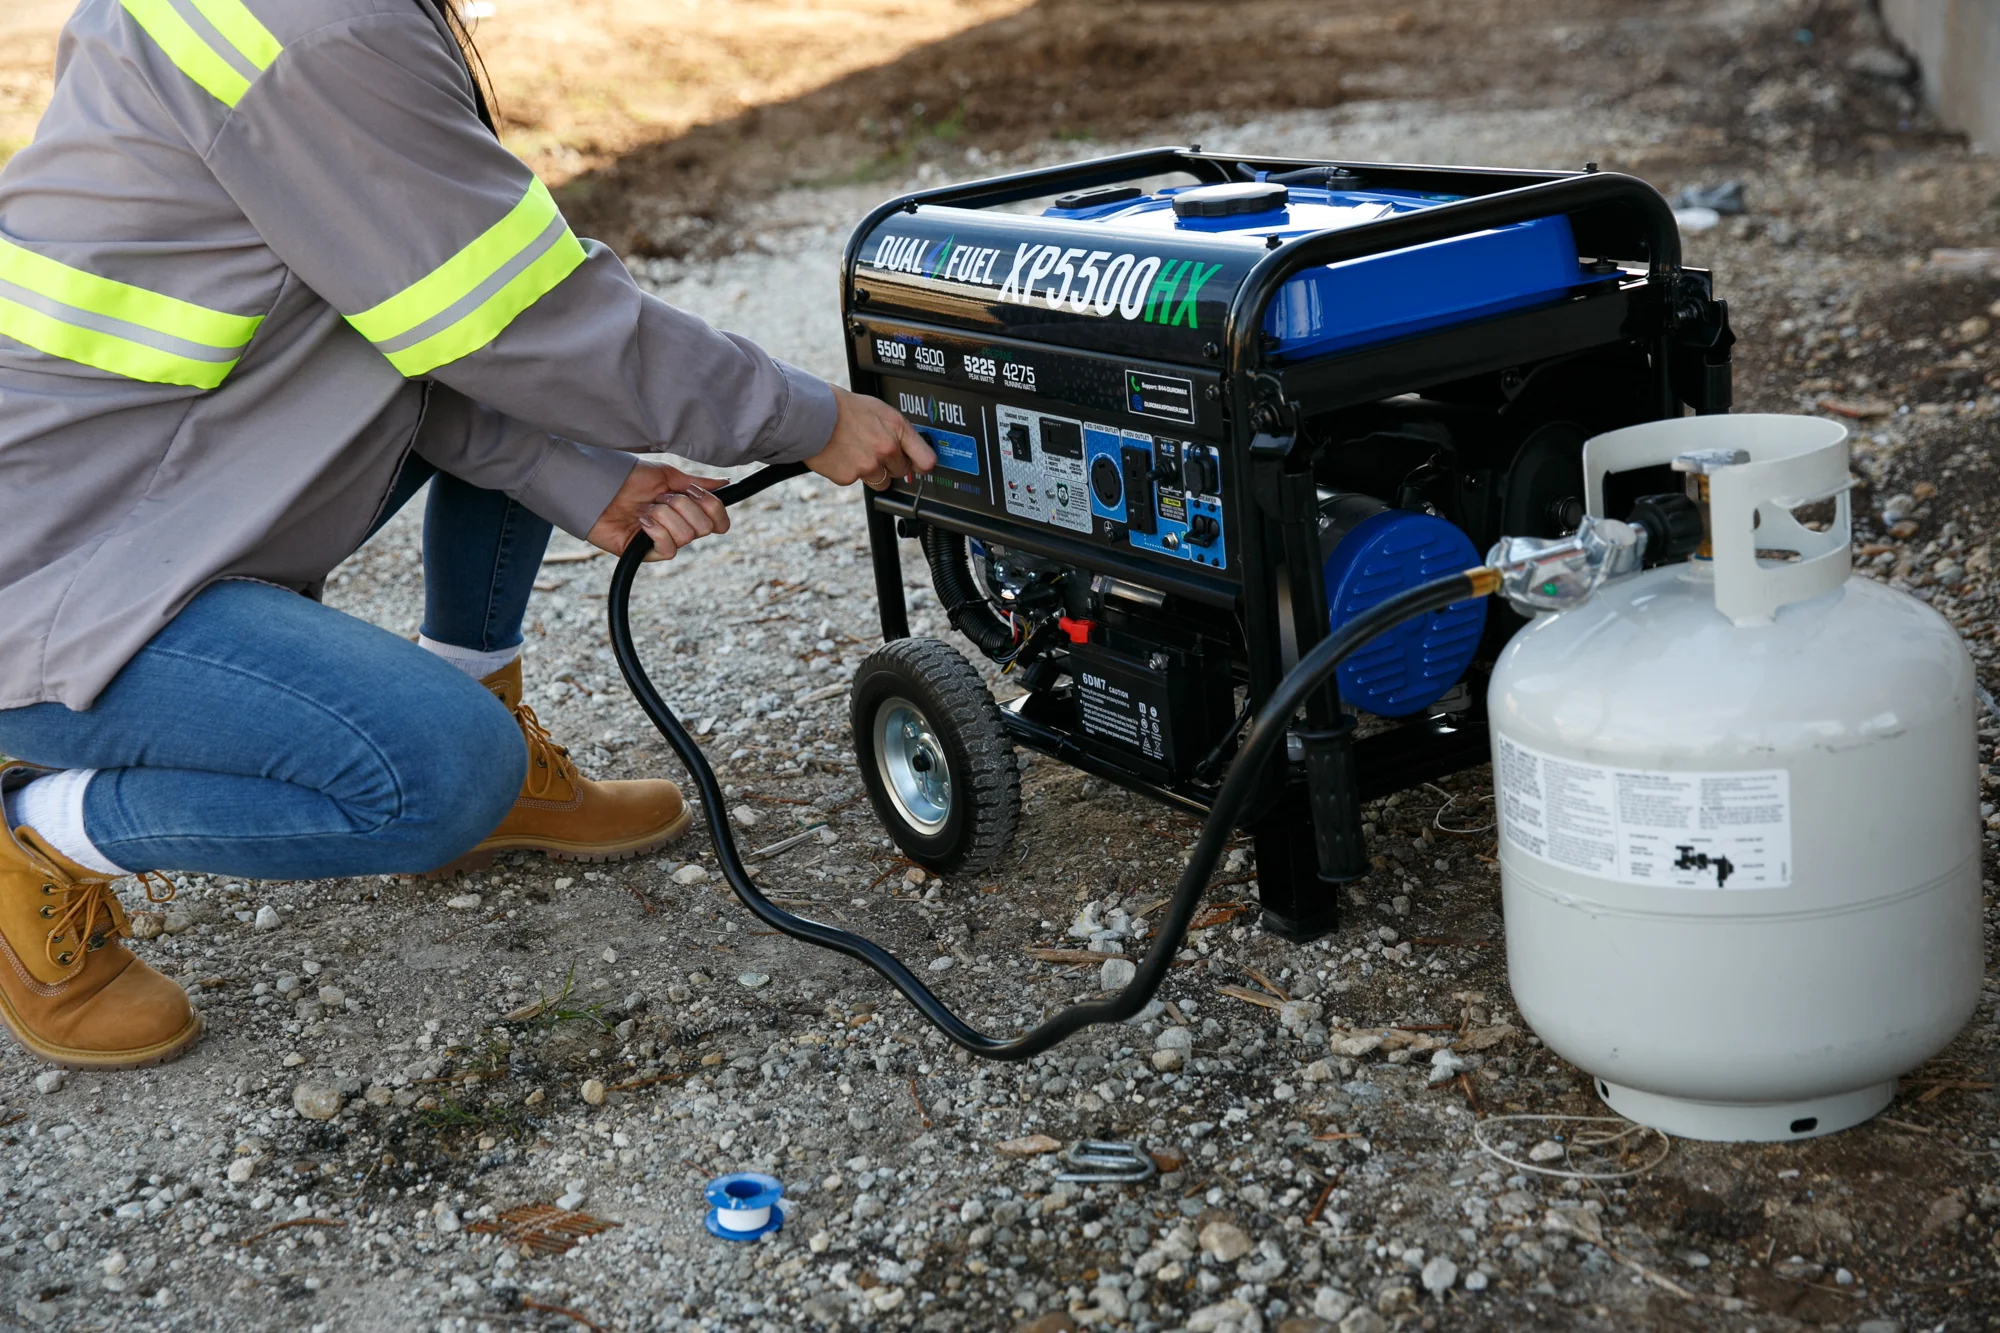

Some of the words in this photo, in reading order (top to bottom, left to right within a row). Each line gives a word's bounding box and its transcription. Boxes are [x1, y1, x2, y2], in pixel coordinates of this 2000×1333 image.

[873, 235, 929, 273] DUAL
[944, 245, 1000, 285] FUEL
[997, 242, 1223, 329] XP5500HX
[876, 339, 906, 360] 5500
[914, 346, 945, 367] 4500
[881, 356, 892, 364] PEAK
[892, 358, 905, 367] WATTS
[916, 362, 933, 372] RUNNING
[933, 366, 946, 374] WATTS
[963, 354, 996, 377] 5225
[1002, 362, 1035, 384] 4275
[968, 372, 980, 380] PEAK
[980, 375, 995, 384] WATTS
[1004, 379, 1021, 390] RUNNING
[1022, 383, 1037, 392] WATTS
[899, 392, 928, 417] DUAL
[938, 401, 966, 427] FUEL
[1104, 426, 1119, 434] OUTLET
[1123, 430, 1134, 438] 120V
[1134, 433, 1150, 441] OUTLET
[1082, 672, 1106, 690] 6DM7
[1108, 686, 1129, 699] CAUTION
